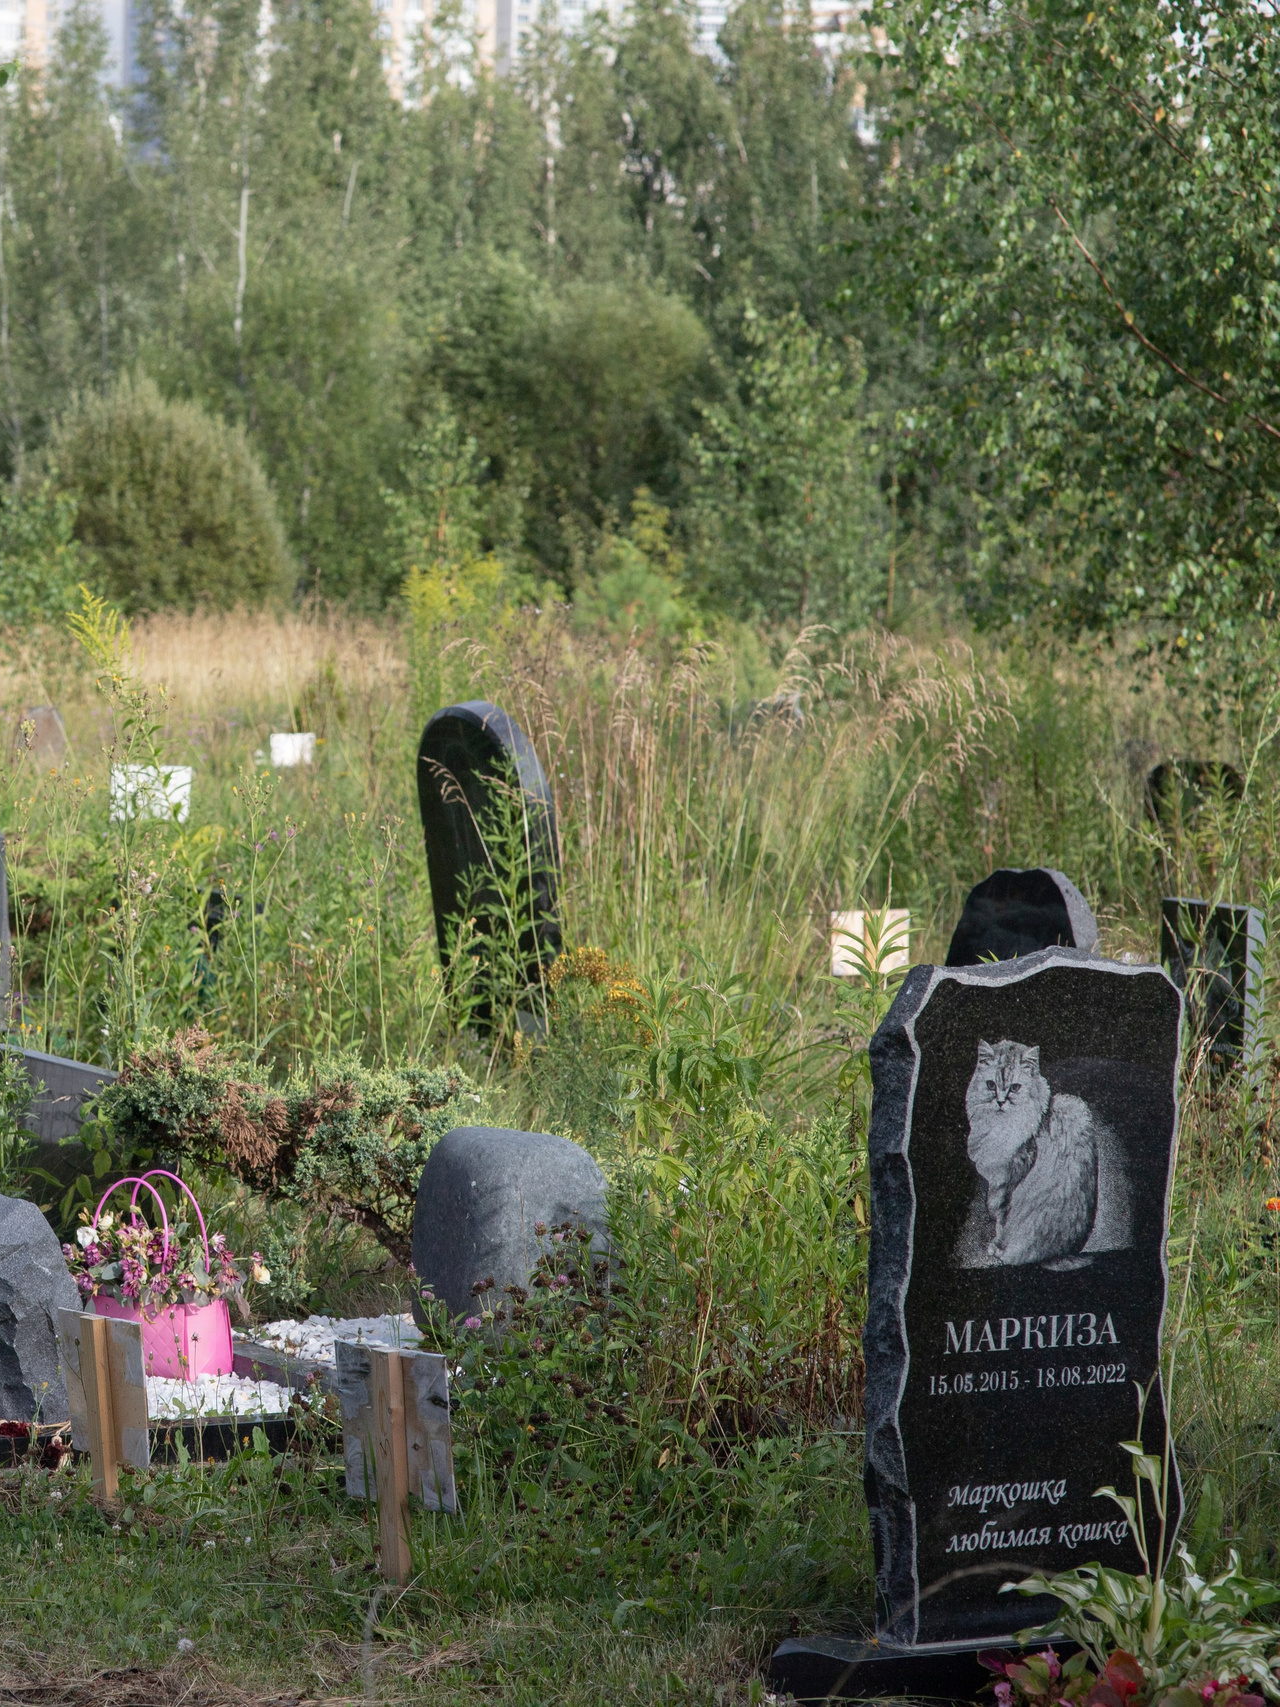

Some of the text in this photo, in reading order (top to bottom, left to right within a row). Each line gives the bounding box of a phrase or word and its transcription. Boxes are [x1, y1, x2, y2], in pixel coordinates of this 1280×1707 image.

[943, 1312, 1121, 1355] МАРКИЗА
[929, 1370, 1020, 1396] 15.05.2015
[1036, 1363, 1127, 1389] 18.08.2022
[947, 1479, 1068, 1514] Маркошка
[945, 1519, 1129, 1553] любимая кошка
